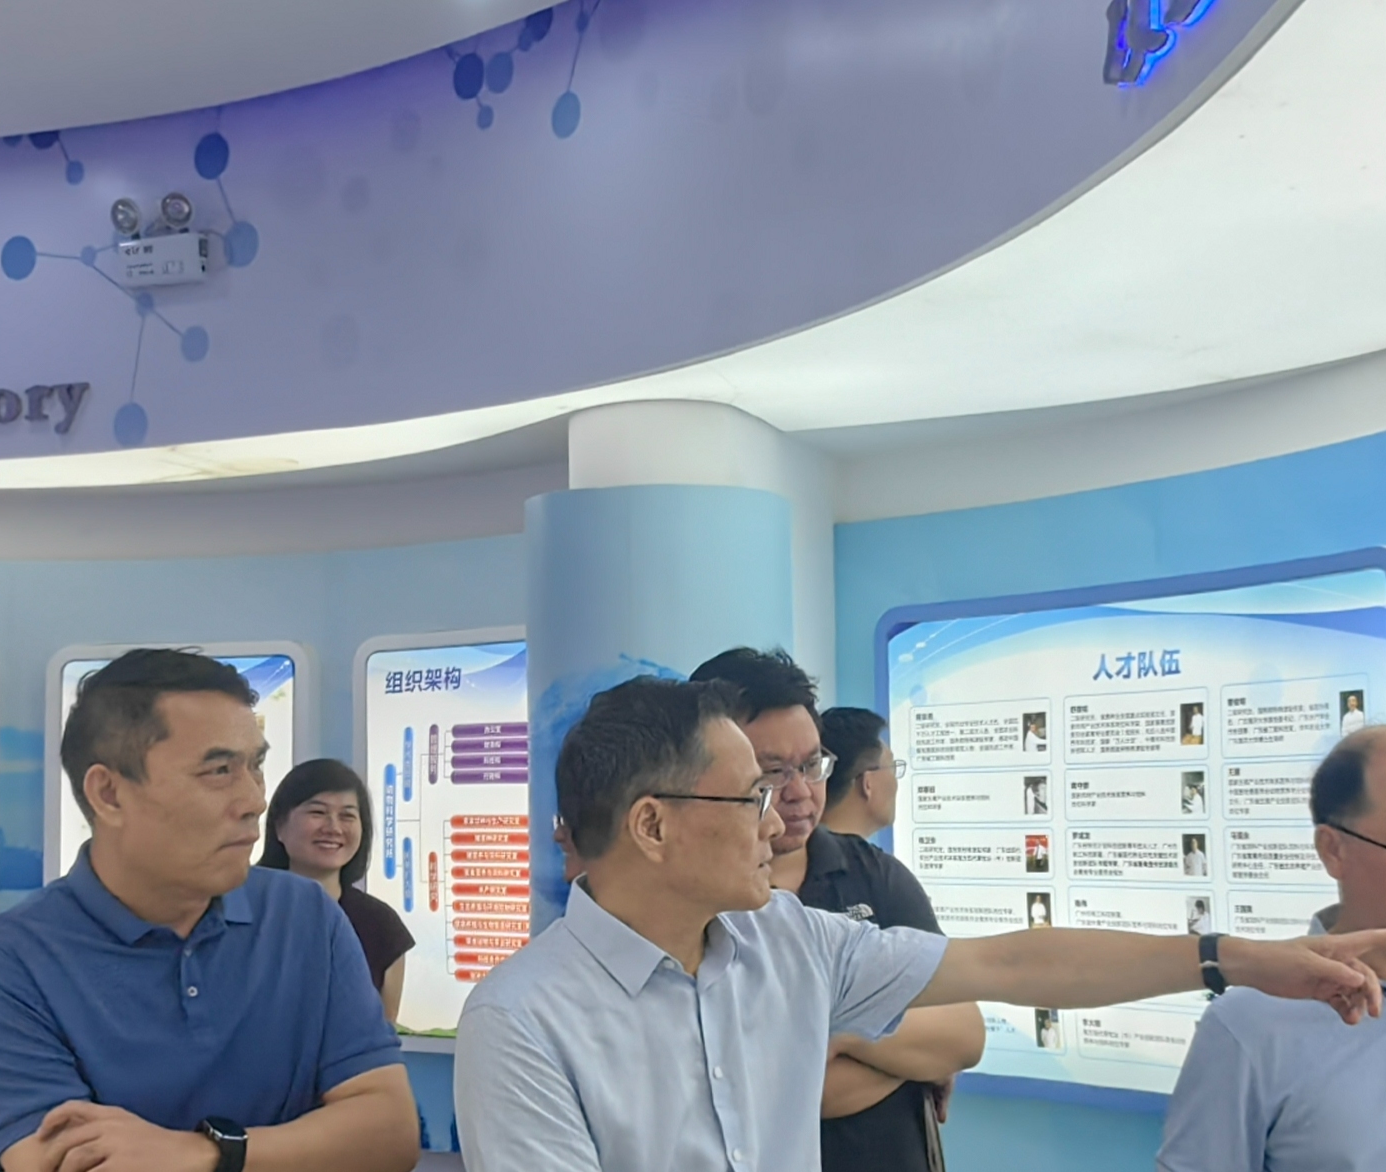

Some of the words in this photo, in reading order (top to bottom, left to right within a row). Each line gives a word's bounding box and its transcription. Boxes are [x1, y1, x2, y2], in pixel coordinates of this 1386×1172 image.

[385, 666, 462, 694] 组织架构
[1092, 650, 1181, 681] 人才队伍
